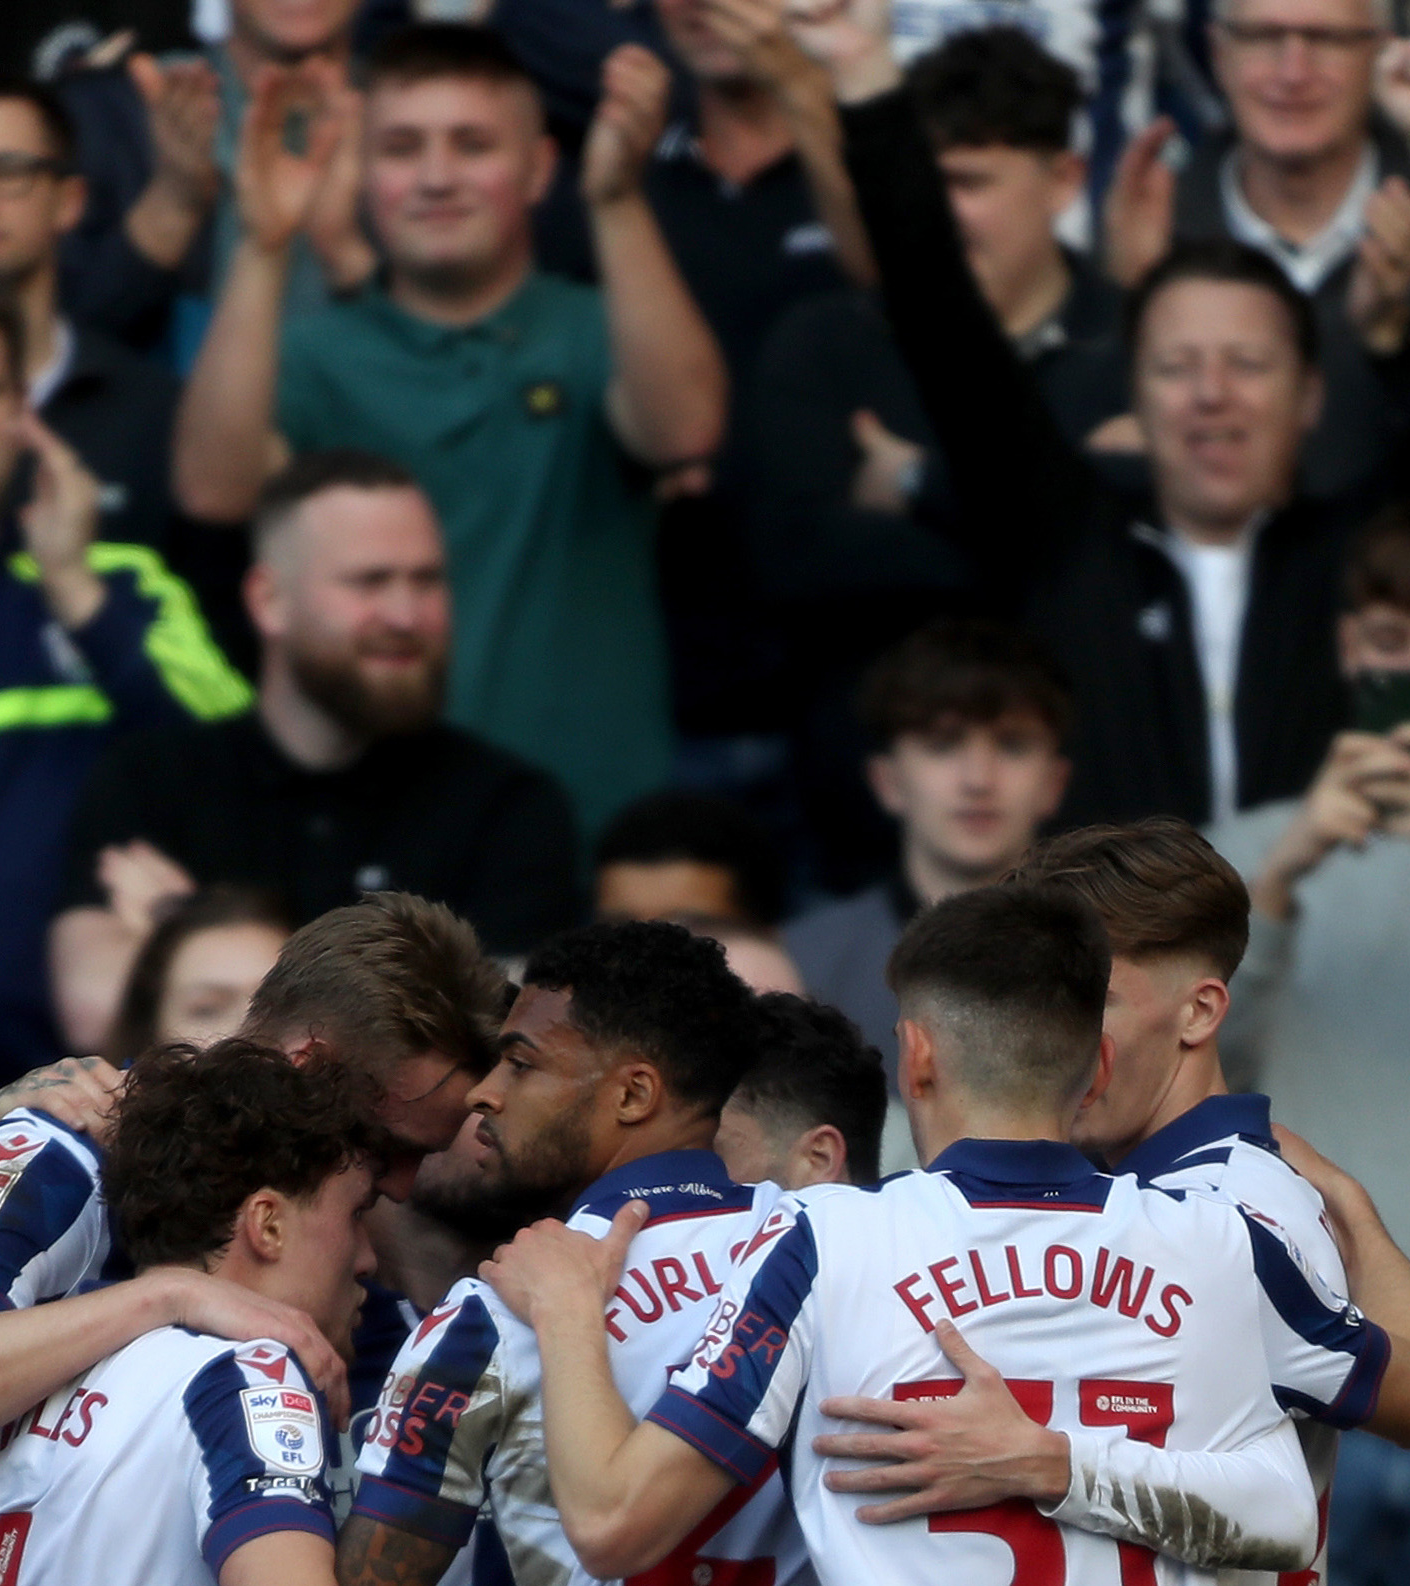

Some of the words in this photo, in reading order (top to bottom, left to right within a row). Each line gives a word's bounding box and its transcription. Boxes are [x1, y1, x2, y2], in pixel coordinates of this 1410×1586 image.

[653, 1185, 675, 1195] are
[678, 1182, 724, 1201] Albion
[892, 1243, 1194, 1338] FELLOWS
[249, 1394, 278, 1408] sky
[1111, 1395, 1125, 1405] EFL
[1125, 1396, 1135, 1405] IN
[1135, 1396, 1150, 1406] THE
[1111, 1402, 1158, 1414] COMMUNITY
[281, 1450, 306, 1464] EFL
